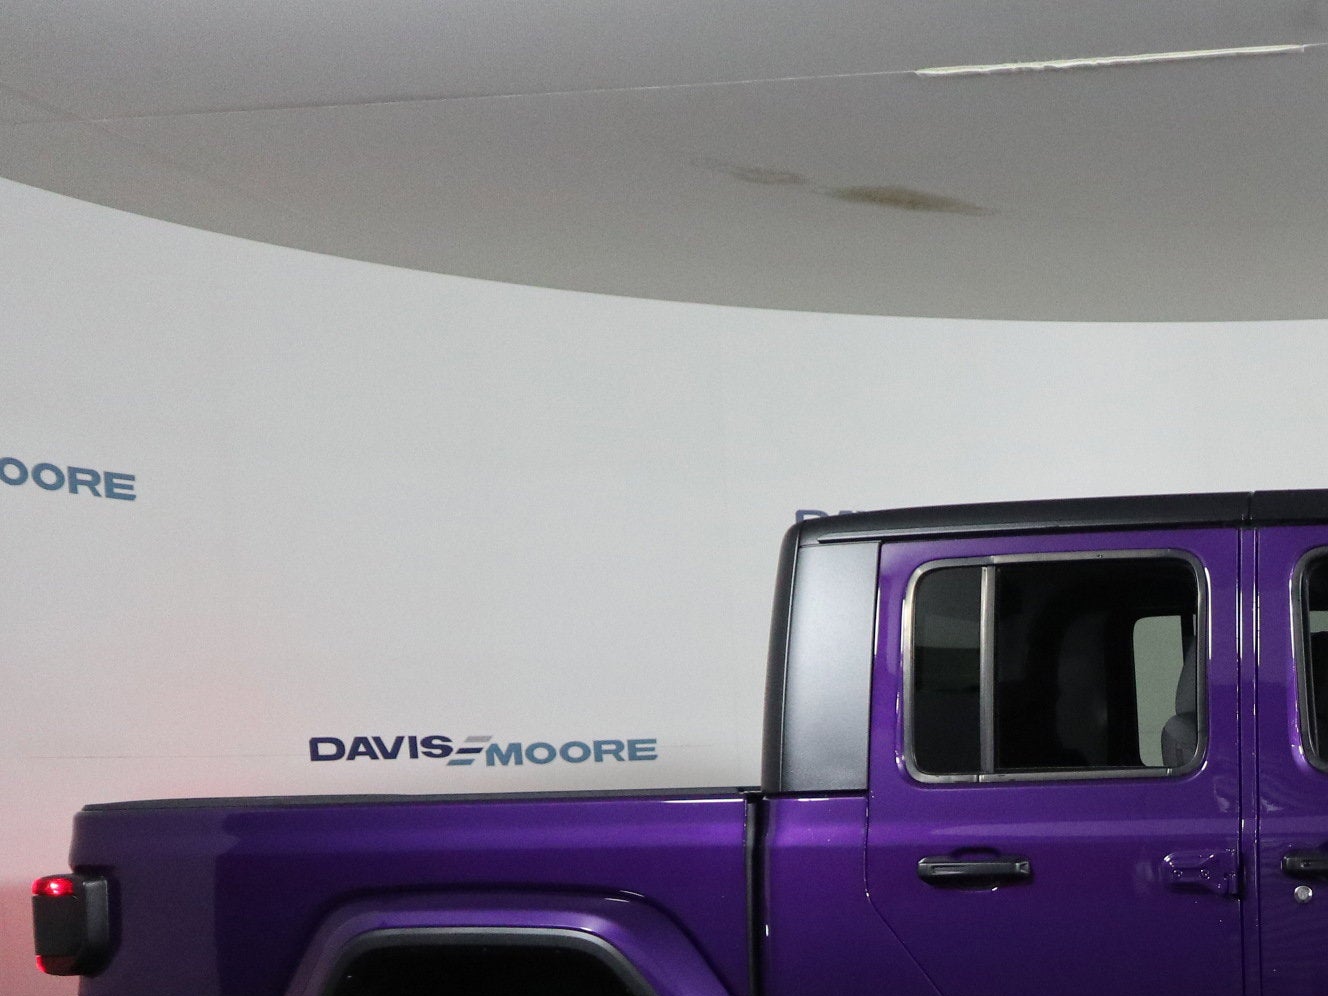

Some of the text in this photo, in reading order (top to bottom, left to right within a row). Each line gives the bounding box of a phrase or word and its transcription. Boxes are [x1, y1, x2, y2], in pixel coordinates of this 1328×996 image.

[0, 456, 137, 501] OORE
[308, 734, 658, 767] DAVIS MOORE
